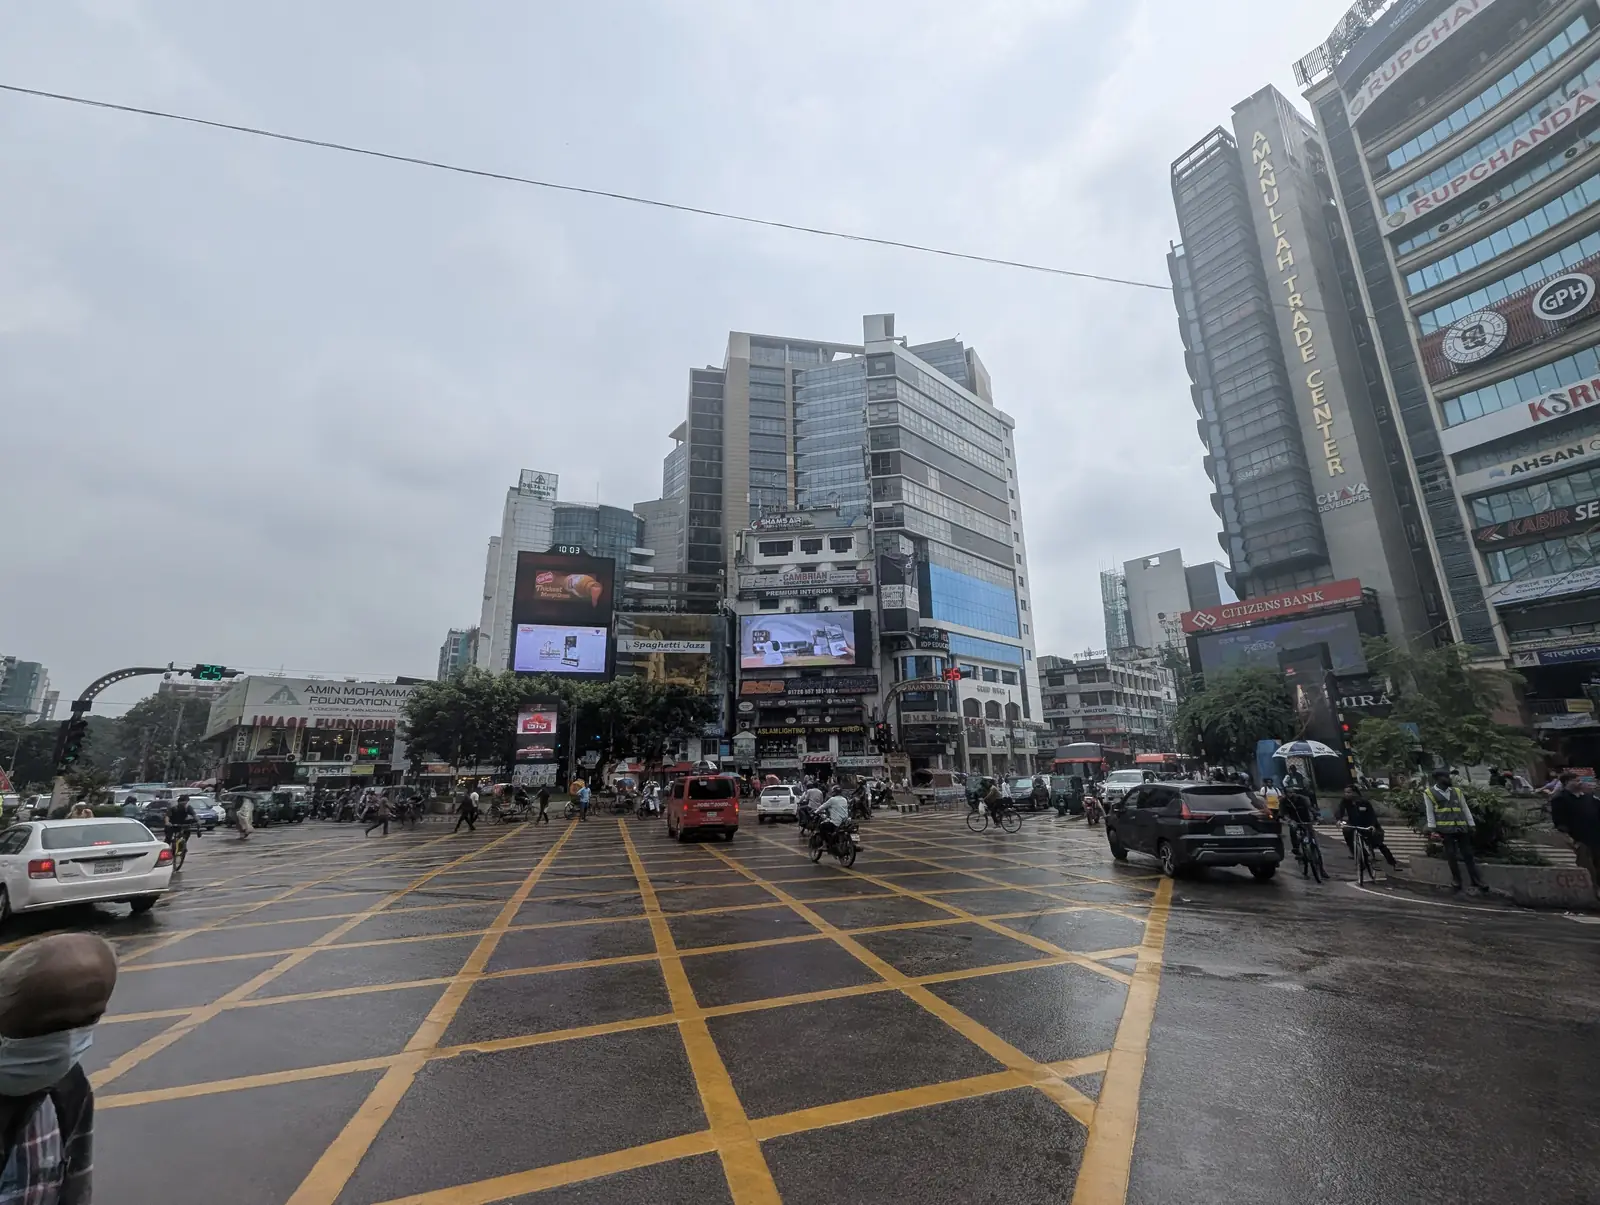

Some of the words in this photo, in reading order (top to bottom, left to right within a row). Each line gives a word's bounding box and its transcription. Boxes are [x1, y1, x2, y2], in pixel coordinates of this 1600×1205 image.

[1367, 0, 1480, 98] RUPCHA
[1252, 130, 1294, 272] AMANULLAH
[1283, 274, 1317, 363] TRADE
[1306, 369, 1345, 477] CENTER
[1542, 282, 1586, 311] GPH
[1510, 445, 1585, 476] AHSAN
[1316, 482, 1370, 506] CHAYA
[1318, 492, 1372, 514] DEVELOPER
[1508, 508, 1571, 537] KABIR
[783, 571, 828, 582] CAMBRIAN
[1221, 599, 1281, 620] CITIZENS
[1283, 590, 1325, 607] BANK
[633, 641, 681, 650] Spaghetti
[683, 641, 706, 649] Jazz
[199, 664, 222, 681] 25
[304, 685, 341, 695] AMIN
[343, 687, 417, 698] MOHAMMA
[309, 696, 391, 707] FOUNDATION
[252, 715, 308, 729] IMAGE
[315, 718, 396, 730] FURNISHIN
[778, 727, 806, 735] LIGHTING
[803, 754, 834, 763] Bata
